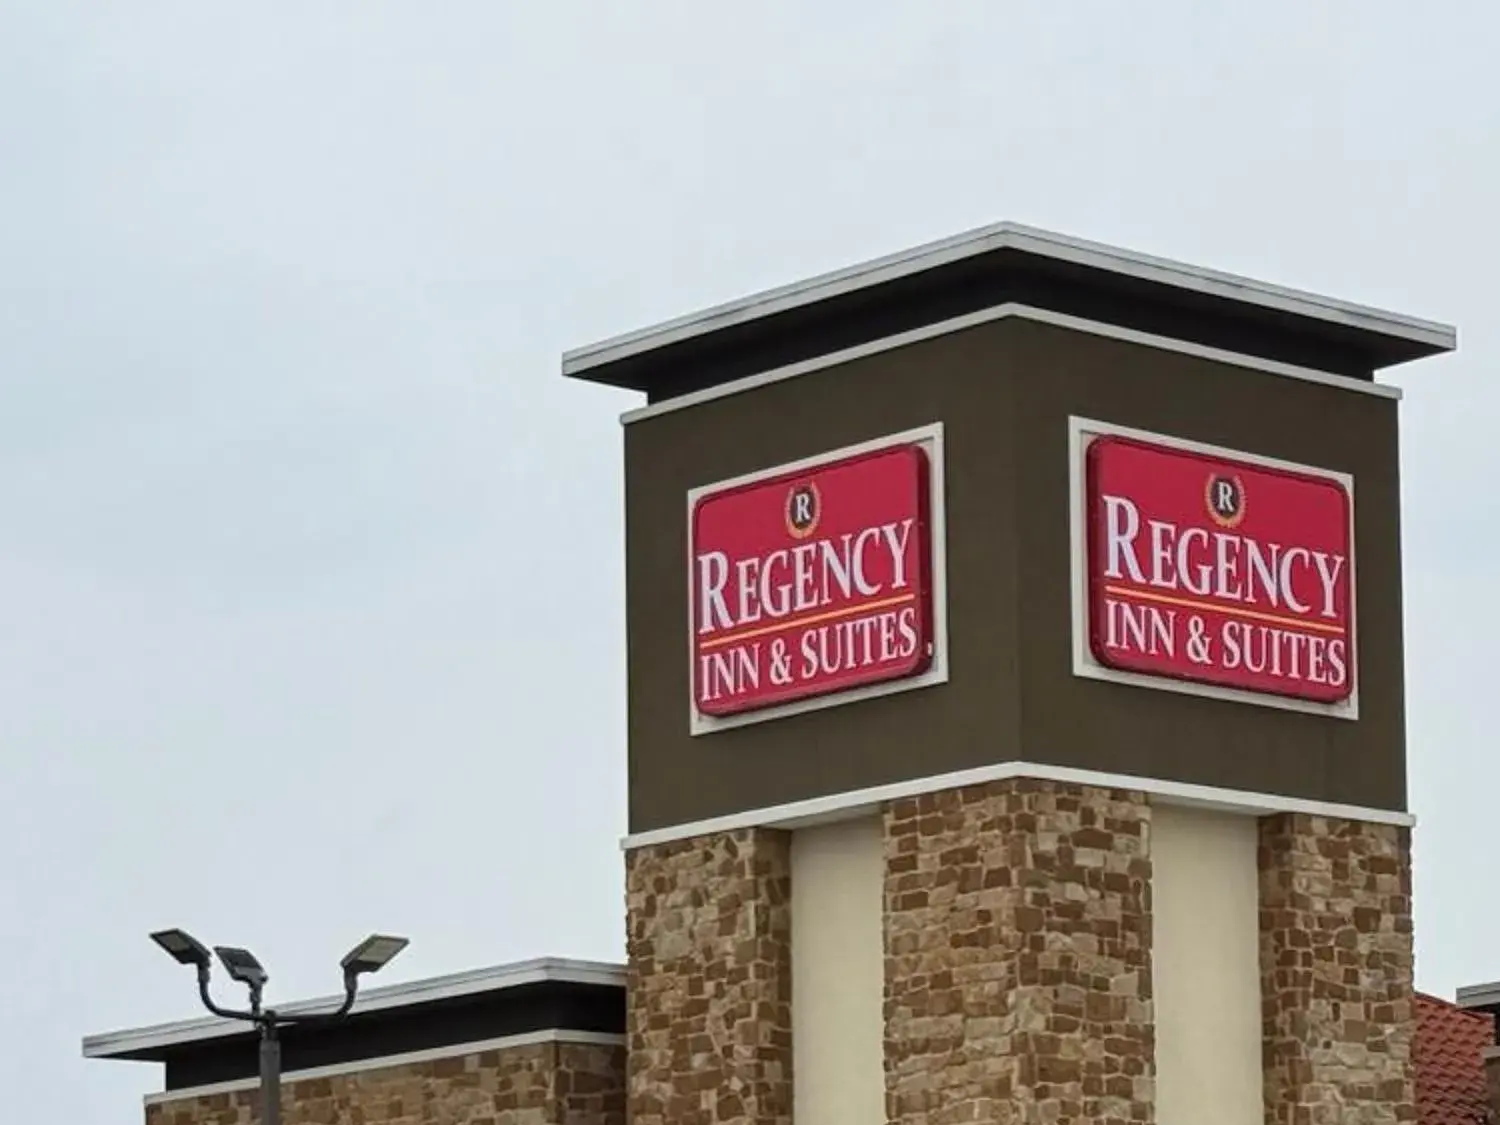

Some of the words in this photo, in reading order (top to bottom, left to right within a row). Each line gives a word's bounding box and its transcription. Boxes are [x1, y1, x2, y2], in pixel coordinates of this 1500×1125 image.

[795, 492, 811, 523] R
[1218, 481, 1234, 512] R
[697, 518, 914, 635] REGENCY
[1102, 494, 1345, 618] REGENCY
[700, 642, 760, 702] INN
[769, 637, 793, 686] &
[801, 606, 917, 680] SUITES
[1105, 599, 1176, 658] INN
[1187, 614, 1213, 666] &
[1222, 620, 1346, 688] SUITES
